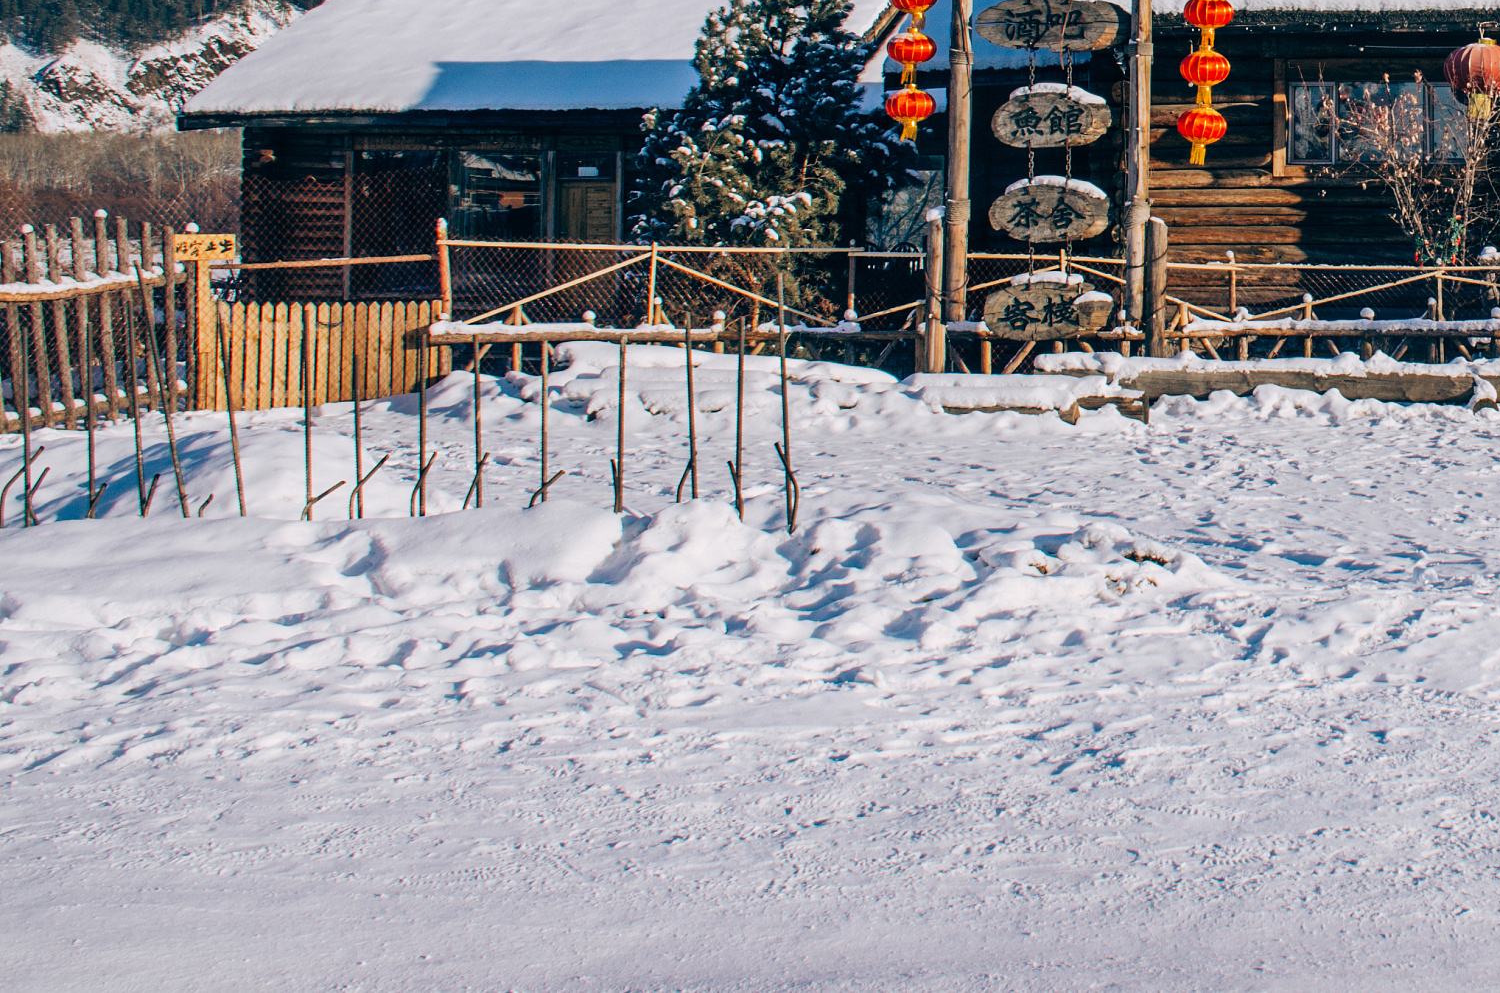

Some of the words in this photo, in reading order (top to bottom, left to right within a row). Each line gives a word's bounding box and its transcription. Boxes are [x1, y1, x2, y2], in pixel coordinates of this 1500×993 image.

[1004, 9, 1085, 41] 酒吧
[1009, 104, 1085, 137] 魚館
[1006, 196, 1086, 230] 茶舍
